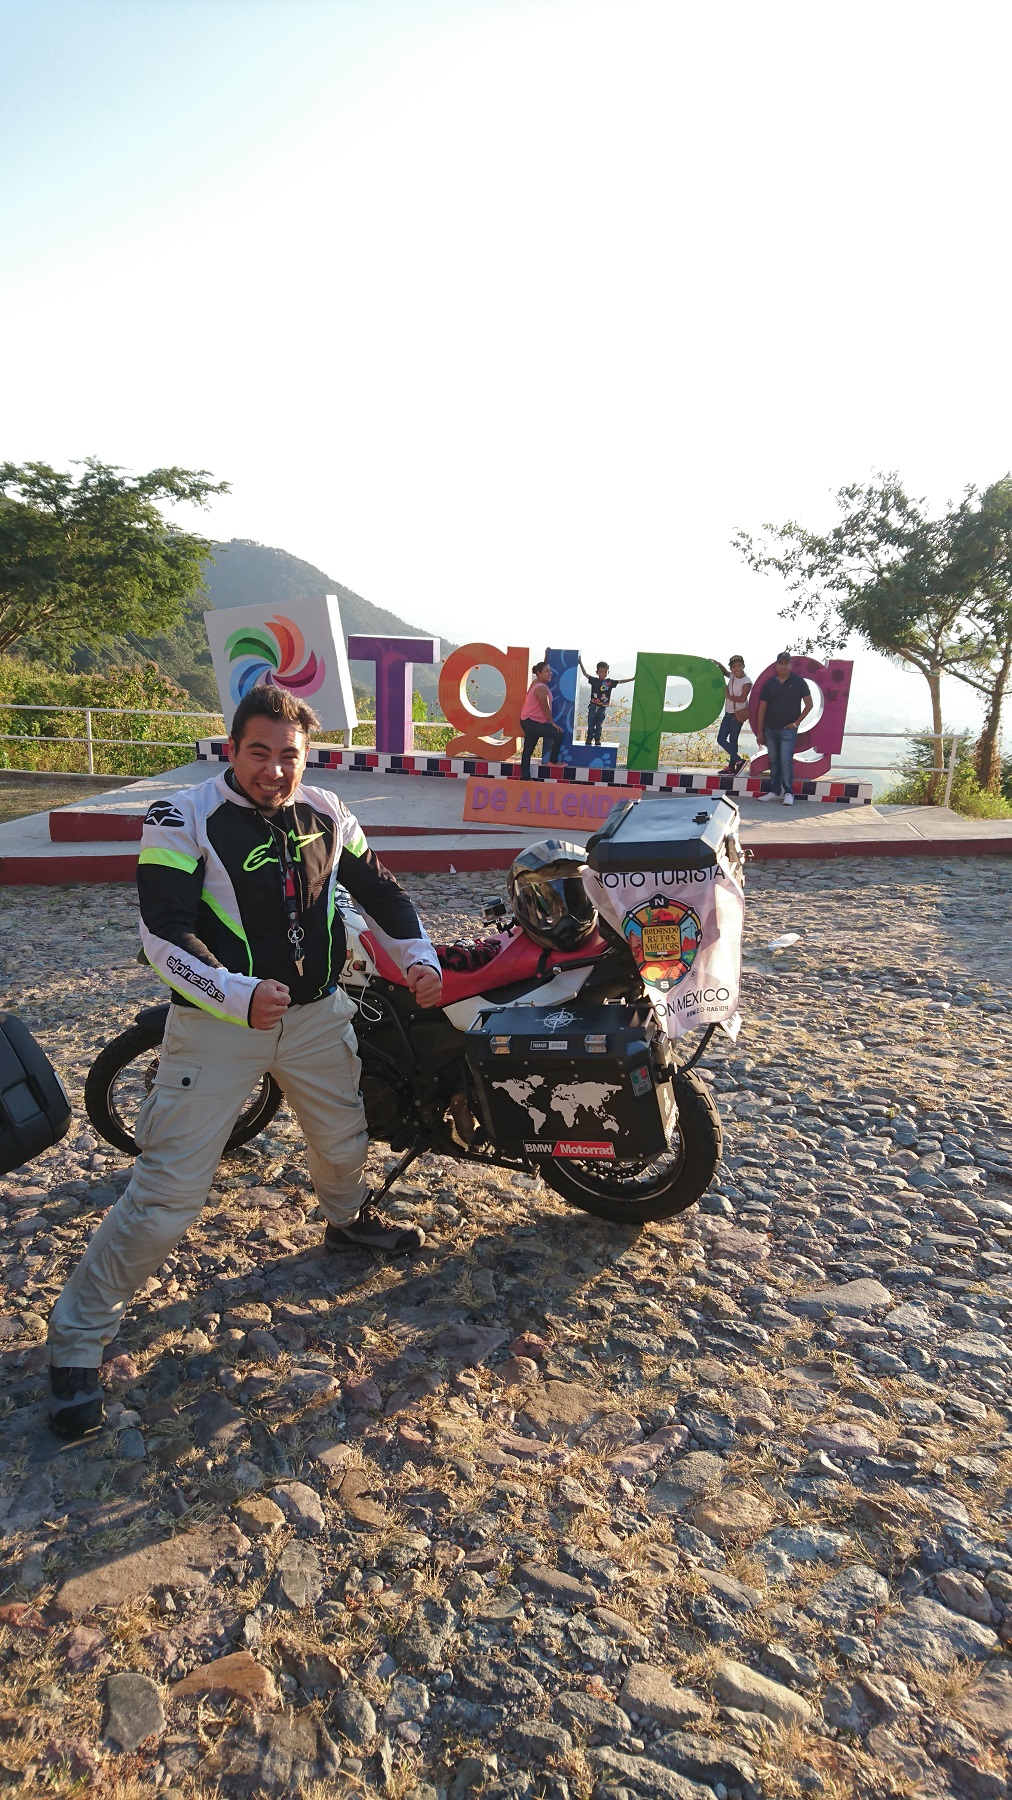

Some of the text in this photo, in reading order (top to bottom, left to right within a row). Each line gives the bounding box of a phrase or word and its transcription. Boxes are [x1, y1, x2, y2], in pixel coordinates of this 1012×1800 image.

[516, 788, 629, 819] ALLeND
[654, 898, 665, 906] N
[167, 955, 225, 1003] alpinestars
[660, 981, 670, 989] S
[677, 987, 730, 1013] MÉXICO
[524, 1143, 616, 1155] BMW Motorrad
